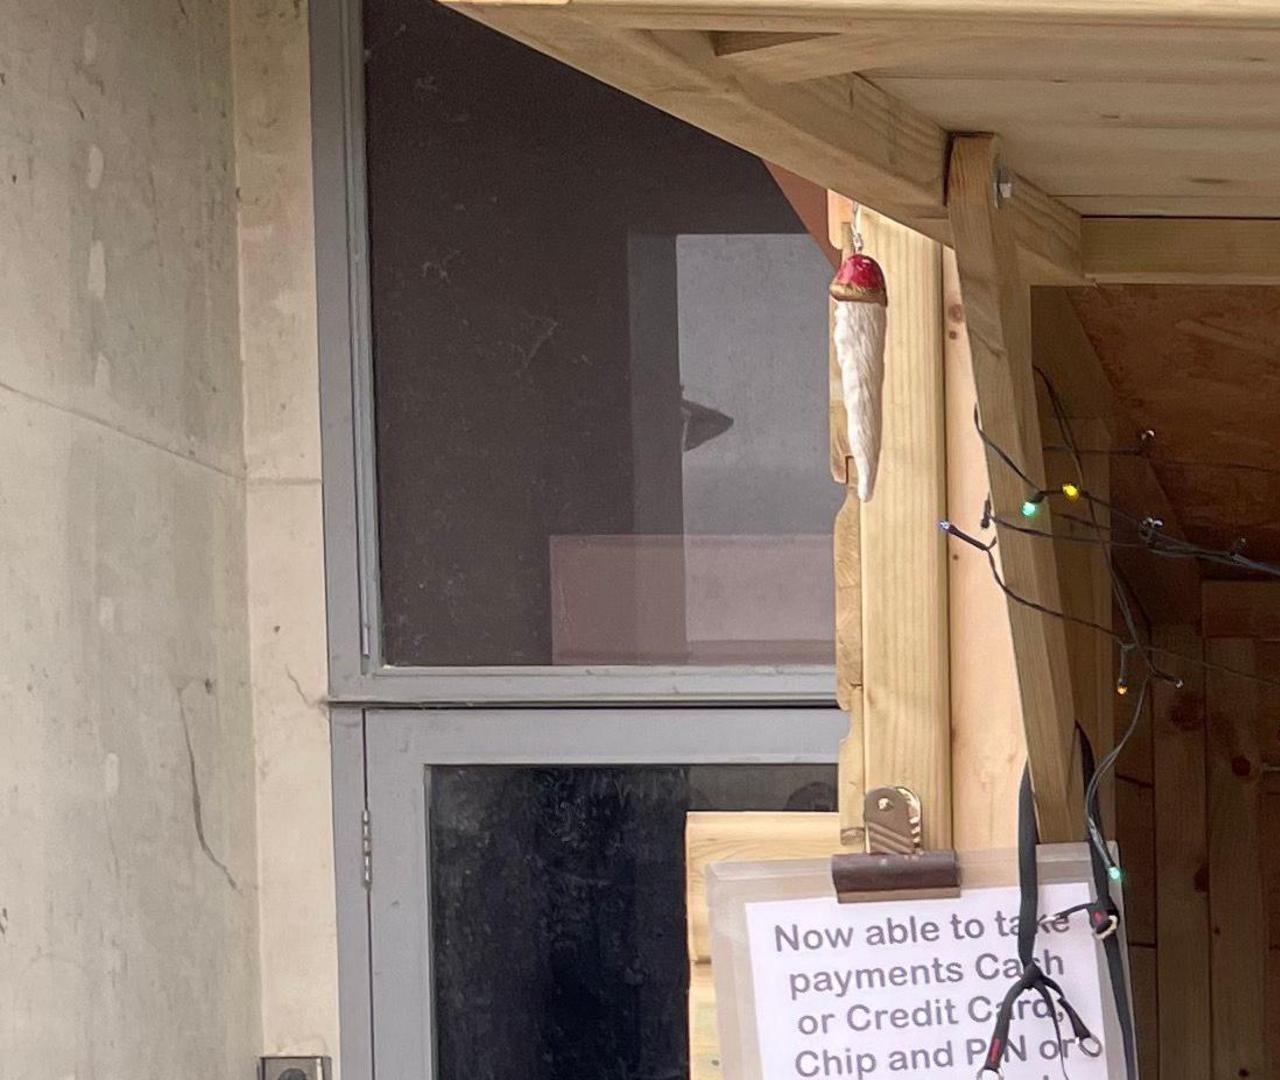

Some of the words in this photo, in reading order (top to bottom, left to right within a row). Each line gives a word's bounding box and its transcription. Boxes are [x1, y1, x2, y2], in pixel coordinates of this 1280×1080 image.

[773, 923, 853, 952] Now
[865, 912, 941, 945] able
[951, 911, 985, 940] to
[789, 958, 964, 1000] payments
[975, 948, 1064, 980] Cah
[798, 1010, 835, 1036] or
[846, 991, 959, 1033] Credit
[968, 994, 1064, 1023] Crd,
[795, 1048, 877, 1080] Chip
[888, 1034, 954, 1071] and
[966, 1035, 1027, 1065] PN
[1039, 1038, 1076, 1060] or
